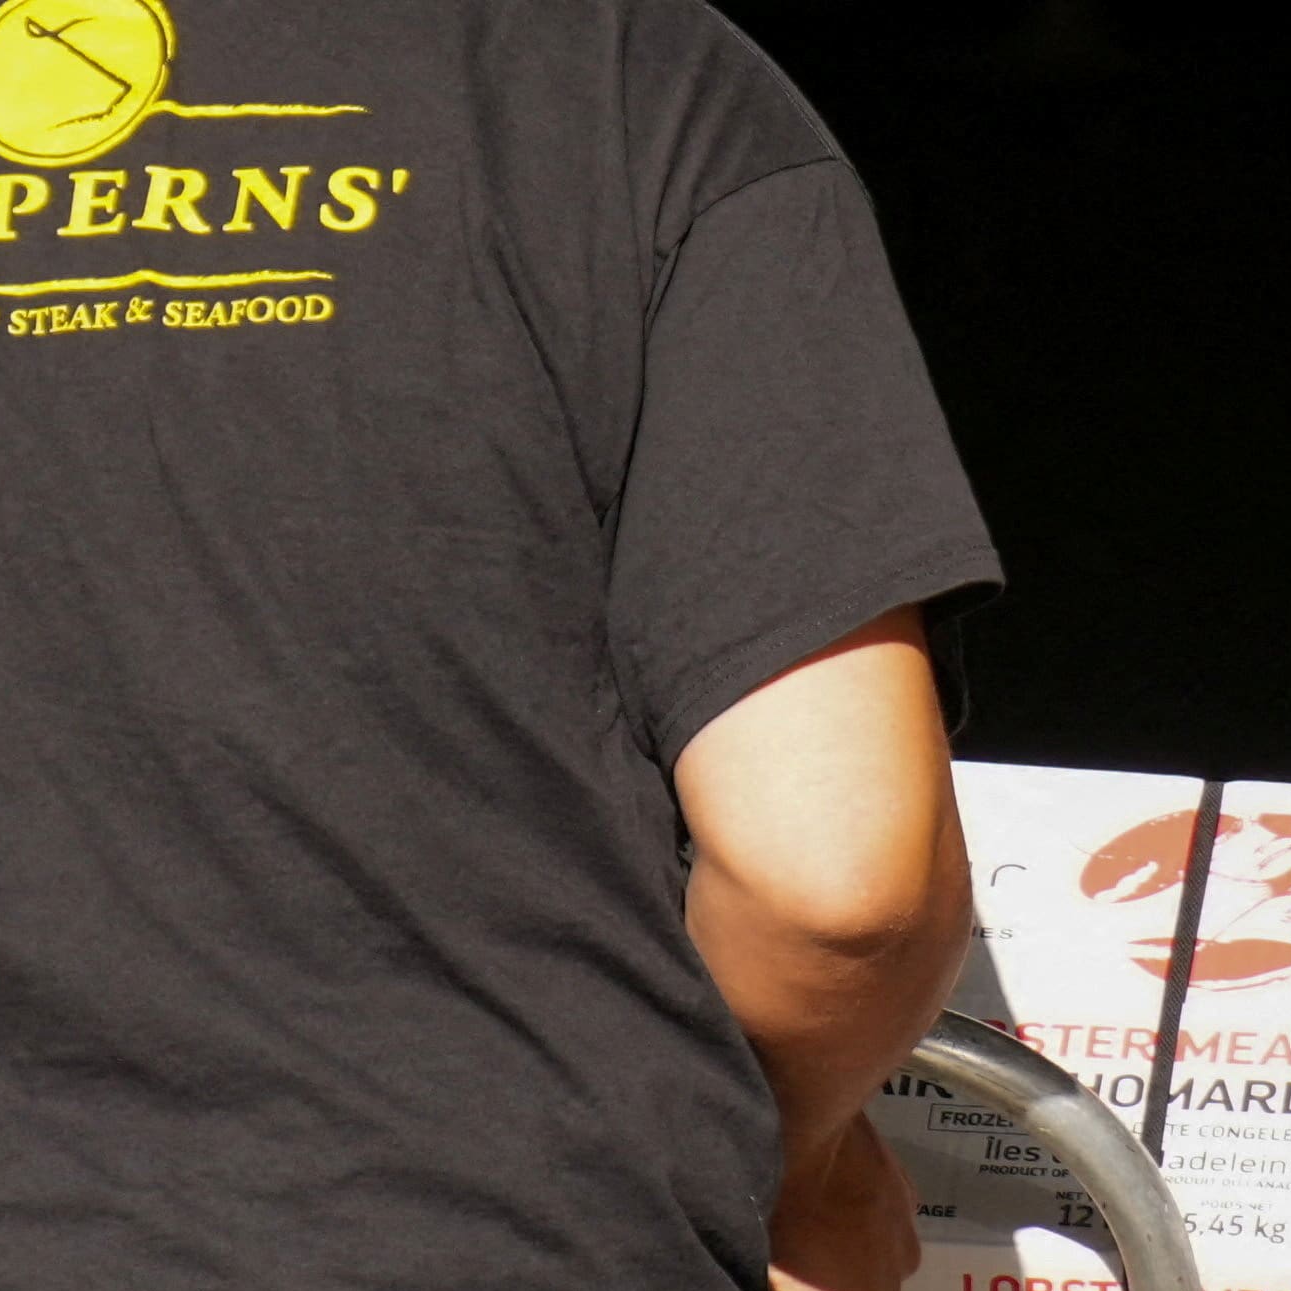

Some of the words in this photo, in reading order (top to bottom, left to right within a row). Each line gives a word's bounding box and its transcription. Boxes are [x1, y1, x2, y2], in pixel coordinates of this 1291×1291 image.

[8, 302, 118, 337] STEAK
[126, 296, 152, 325] &
[162, 295, 334, 329] SEAFOOD
[982, 1019, 1159, 1063] STER
[940, 1110, 1014, 1129] FROZE
[979, 1164, 1048, 1177] PRODUCT
[1055, 1191, 1083, 1201] NET
[1058, 1204, 1095, 1228] 12
[1254, 1215, 1287, 1245] kg
